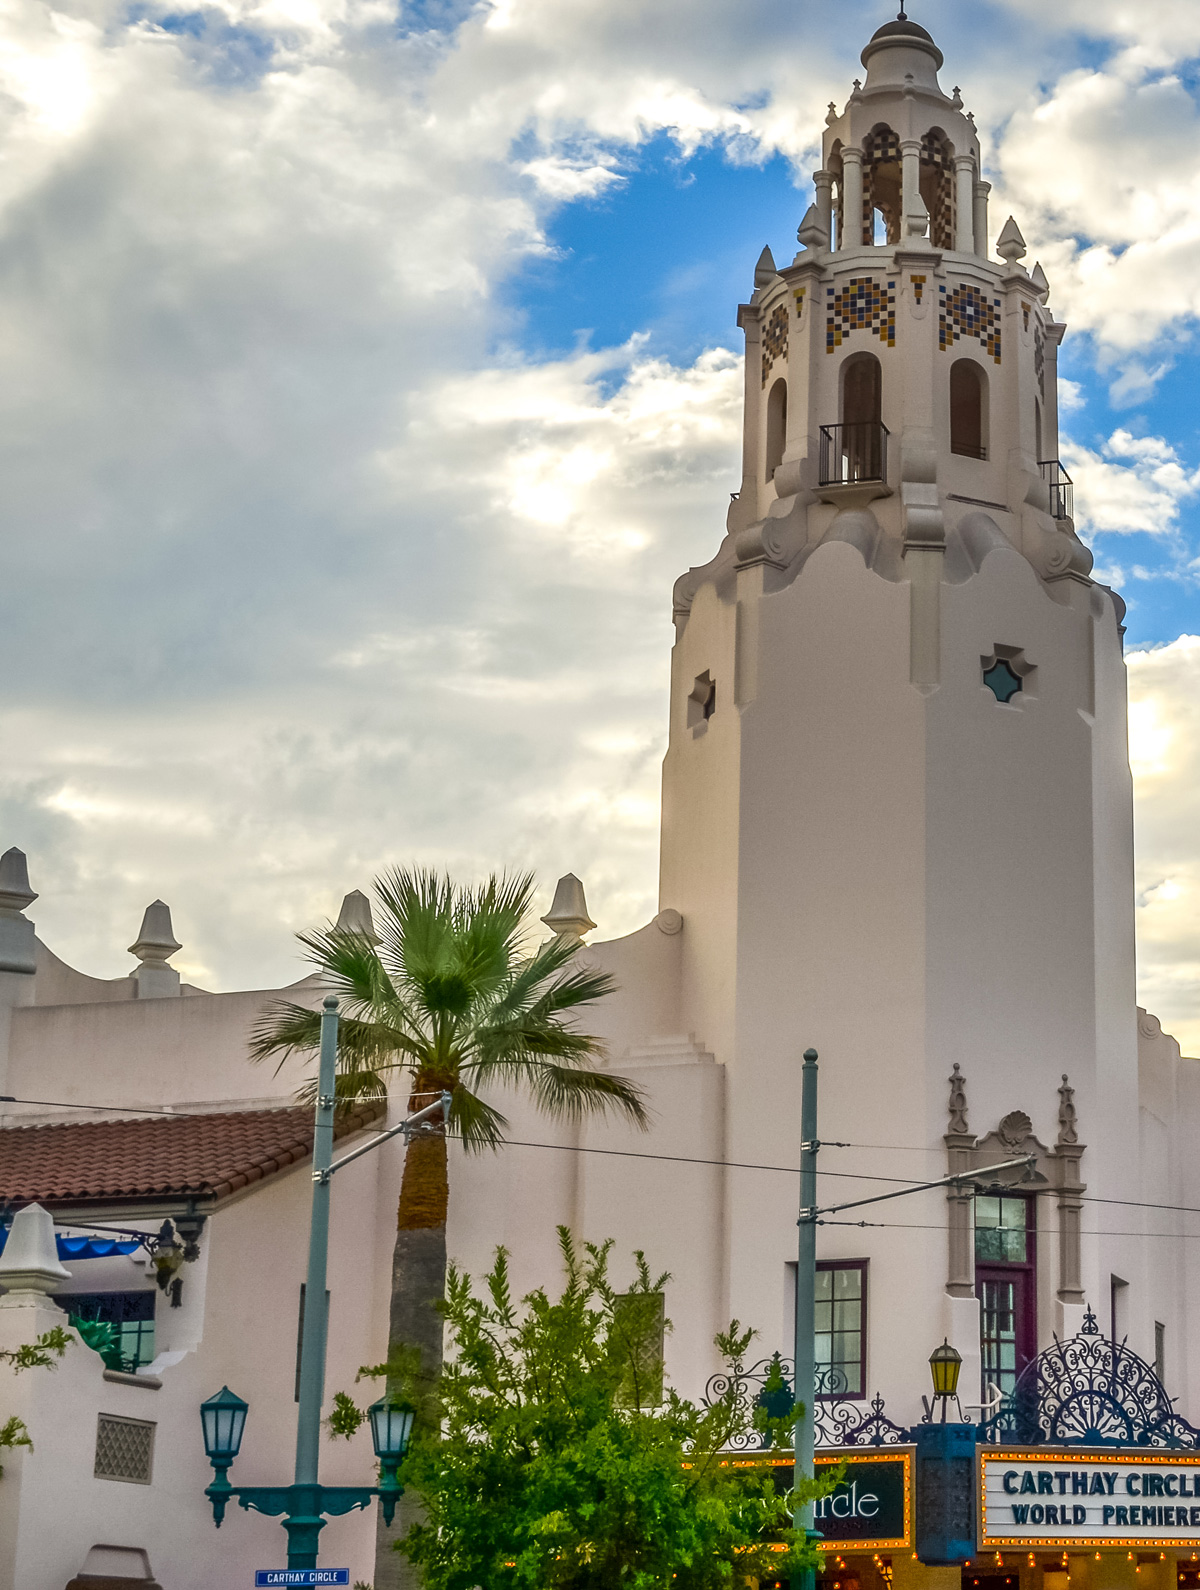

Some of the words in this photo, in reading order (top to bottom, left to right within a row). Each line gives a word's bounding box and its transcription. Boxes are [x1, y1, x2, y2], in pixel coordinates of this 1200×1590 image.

[1002, 1470, 1119, 1497] CARTHAY
[1010, 1503, 1086, 1525] WORLD
[1102, 1504, 1200, 1526] PREMIERE
[267, 1573, 305, 1583] CARTHAY
[309, 1572, 337, 1582] CIRCLE
